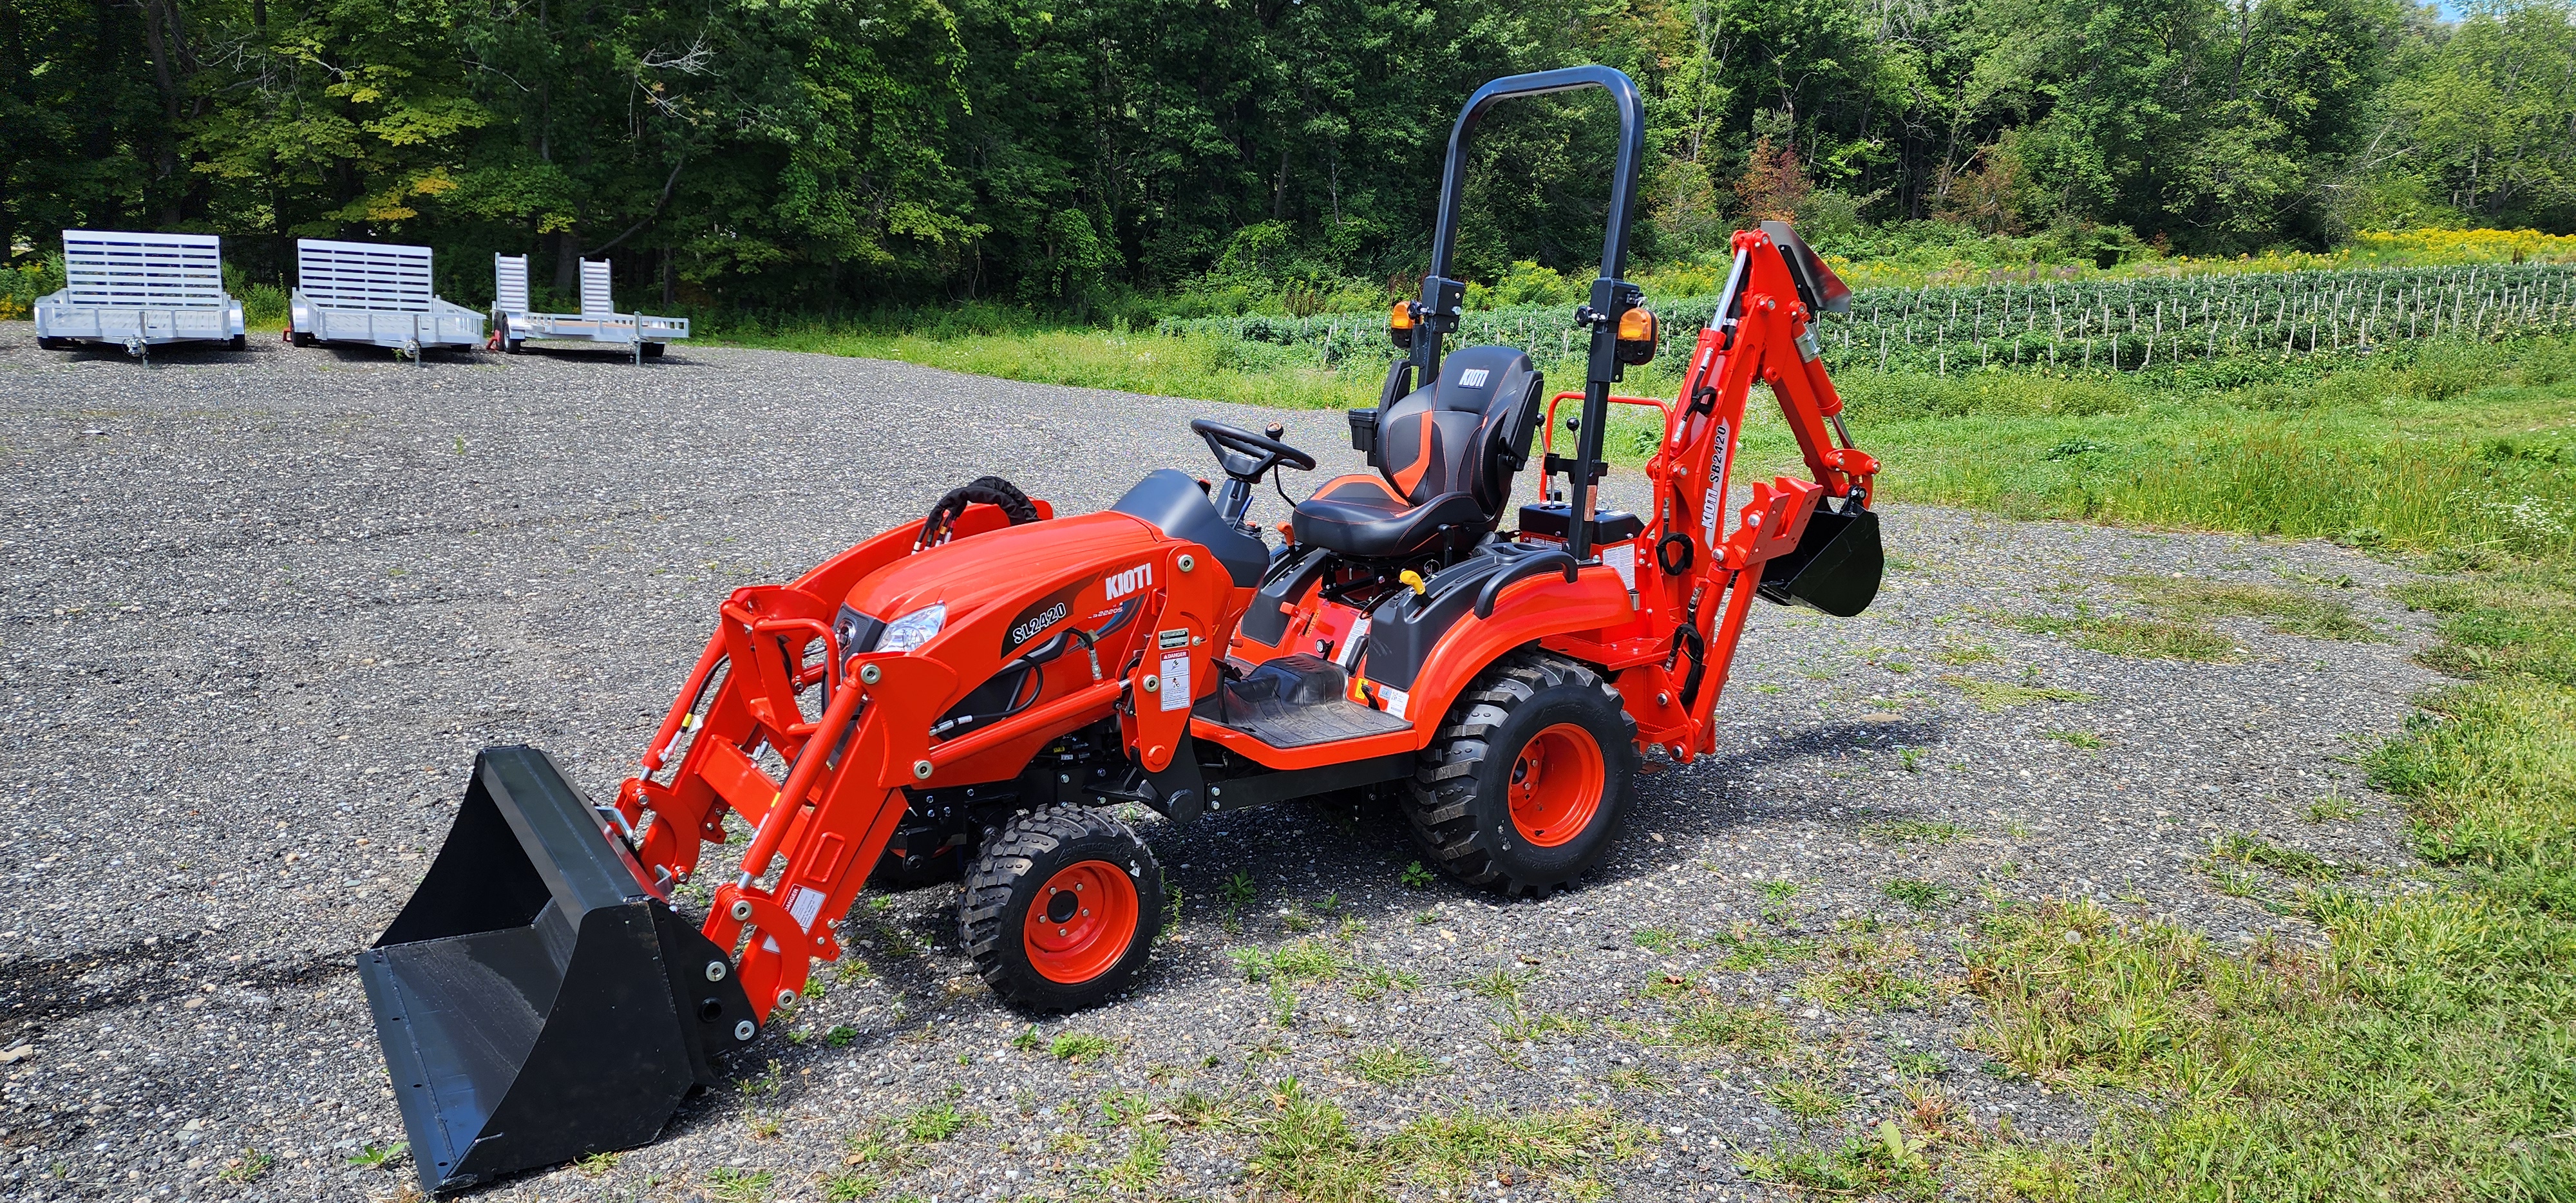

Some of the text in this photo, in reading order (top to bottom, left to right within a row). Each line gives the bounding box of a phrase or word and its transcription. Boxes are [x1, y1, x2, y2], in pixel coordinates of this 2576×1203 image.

[1459, 368, 1490, 386] KIOTI
[1701, 425, 1727, 529] KIOTI SB2420
[1106, 562, 1152, 600] KIOTI
[1012, 602, 1066, 644] SL2420
